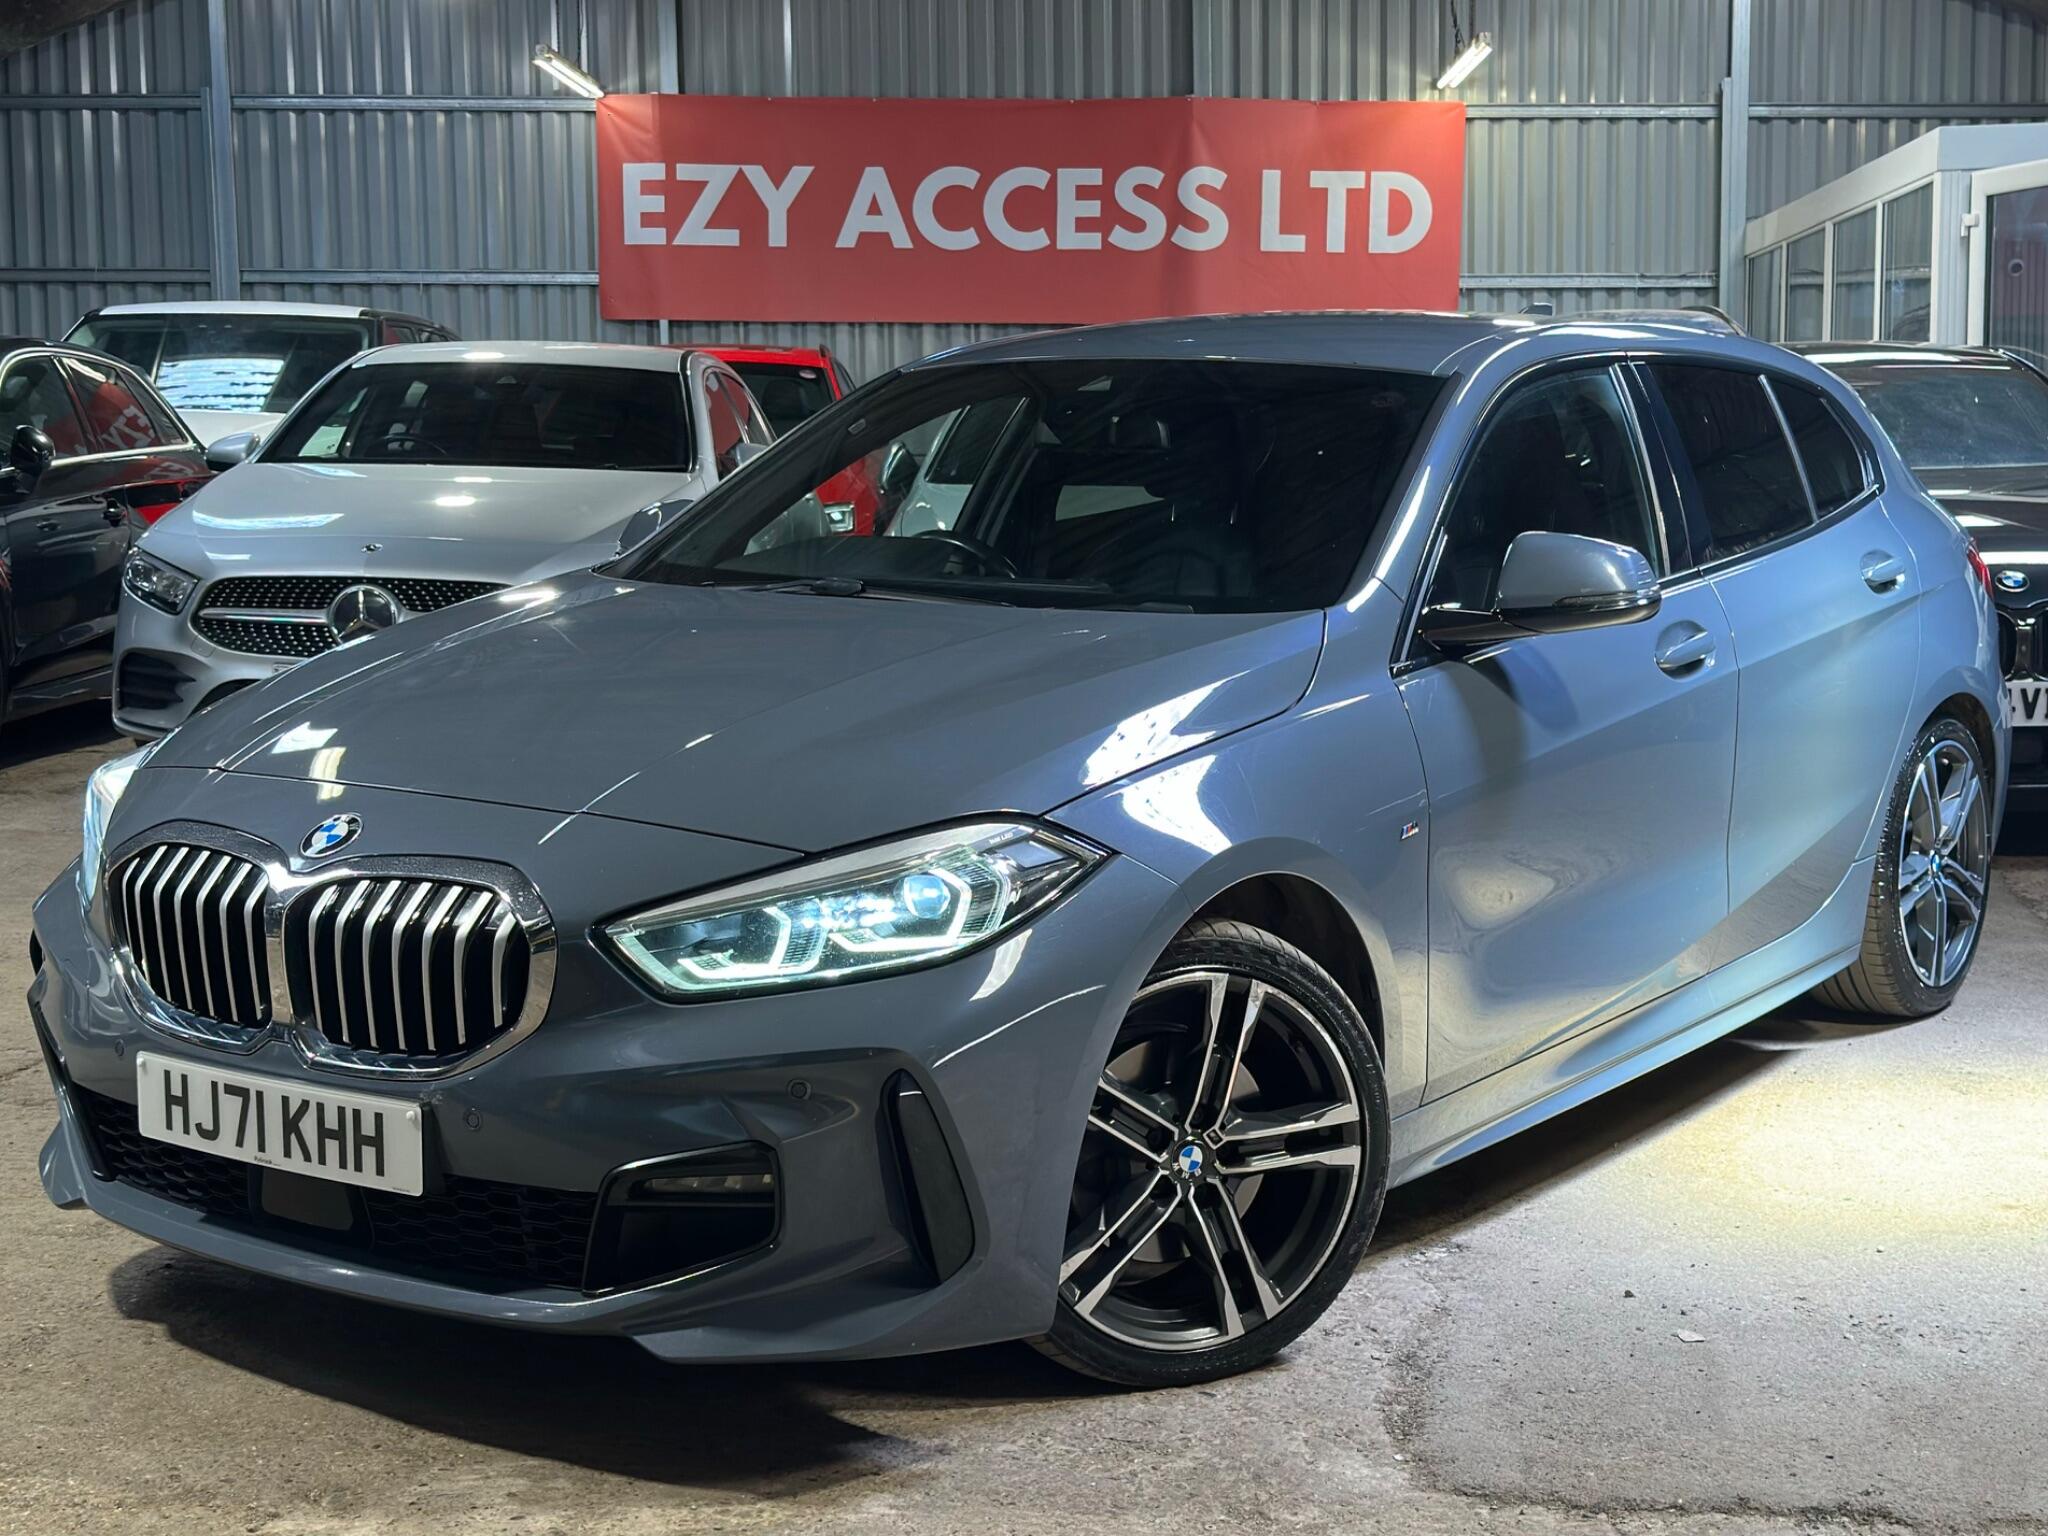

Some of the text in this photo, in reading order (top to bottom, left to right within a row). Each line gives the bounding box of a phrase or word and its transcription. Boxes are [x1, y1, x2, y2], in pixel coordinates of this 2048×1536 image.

[622, 162, 1433, 254] EZY ACCESS LTD
[164, 1069, 385, 1177] HJ71 KHH
